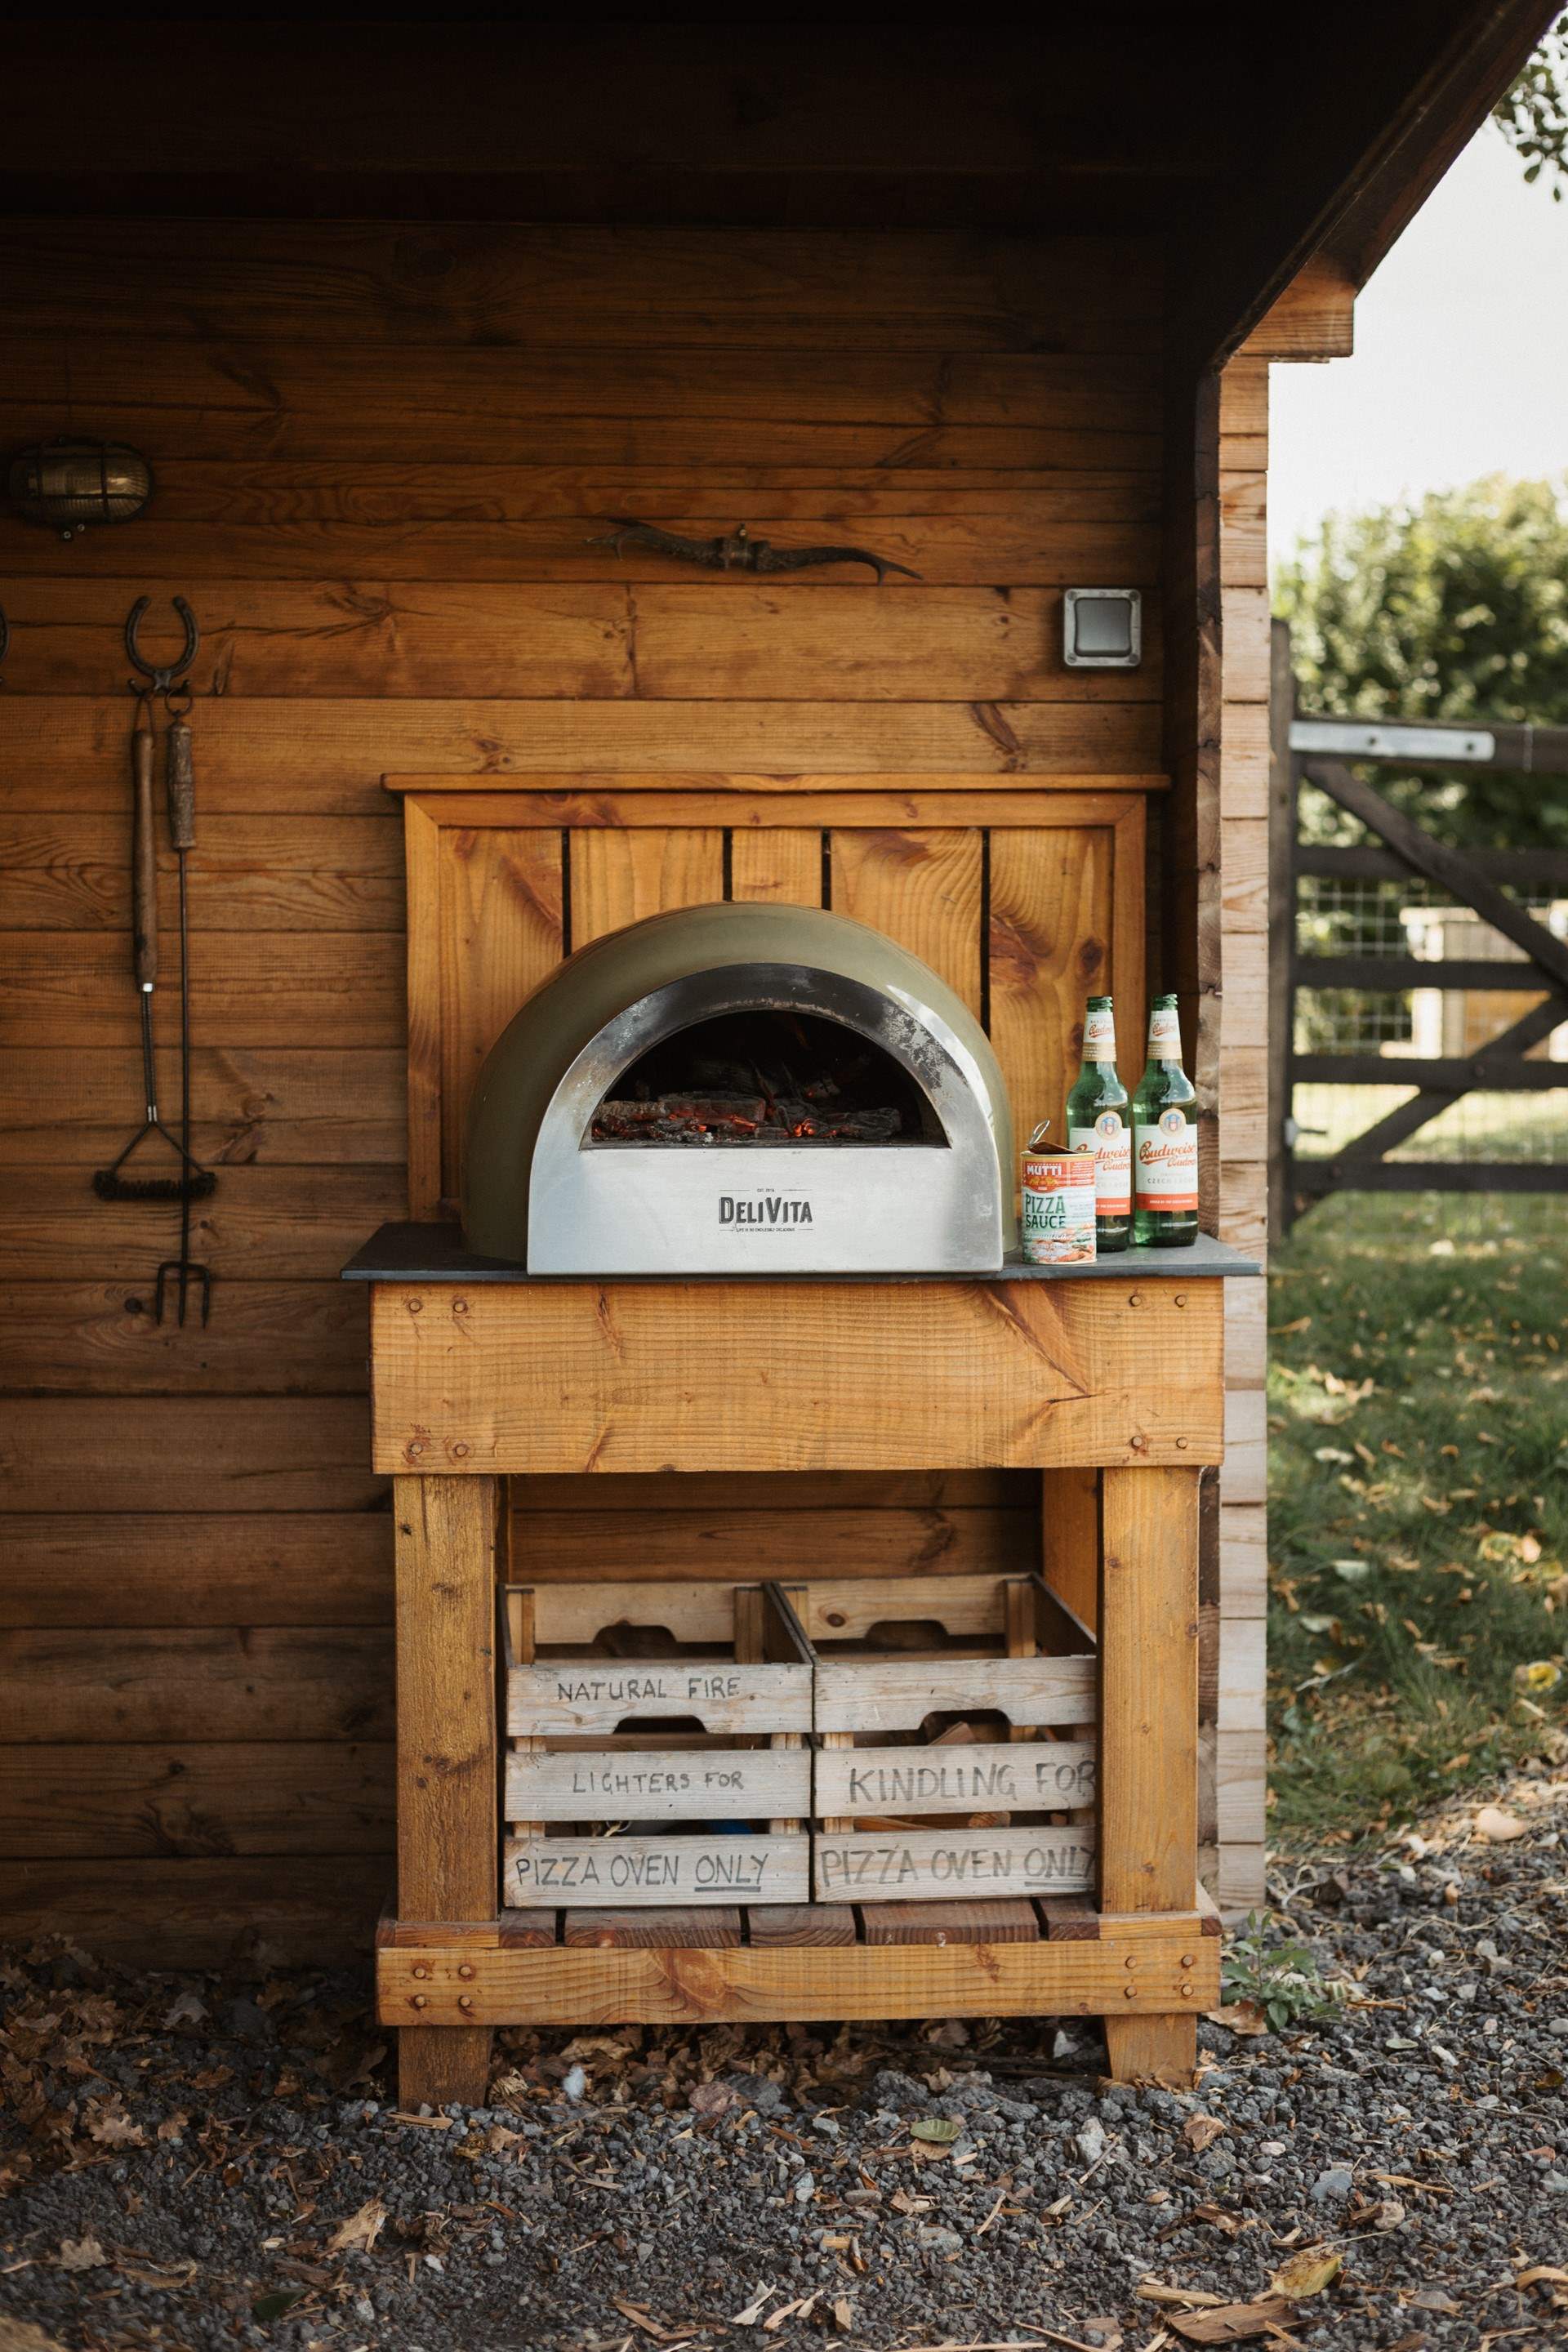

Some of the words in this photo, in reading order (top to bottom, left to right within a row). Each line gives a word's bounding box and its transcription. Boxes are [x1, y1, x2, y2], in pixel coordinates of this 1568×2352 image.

[719, 1197, 813, 1223] DELIVITA
[1025, 1193, 1065, 1214] PIZZA
[1026, 1214, 1066, 1228] SAUCE
[557, 1679, 666, 1701] NATURAL
[688, 1677, 741, 1699] FIRE
[573, 1771, 690, 1795] LIGHTERS
[705, 1771, 745, 1790] FOR
[849, 1763, 1018, 1802] KINDLING
[1036, 1760, 1095, 1794] FOR
[516, 1856, 600, 1886] PIZZA
[610, 1855, 679, 1887] OVEN
[695, 1853, 768, 1886] ONLY
[821, 1849, 919, 1887] PIZZA
[931, 1849, 1012, 1880] OVEN
[1024, 1846, 1096, 1879] ONLY
